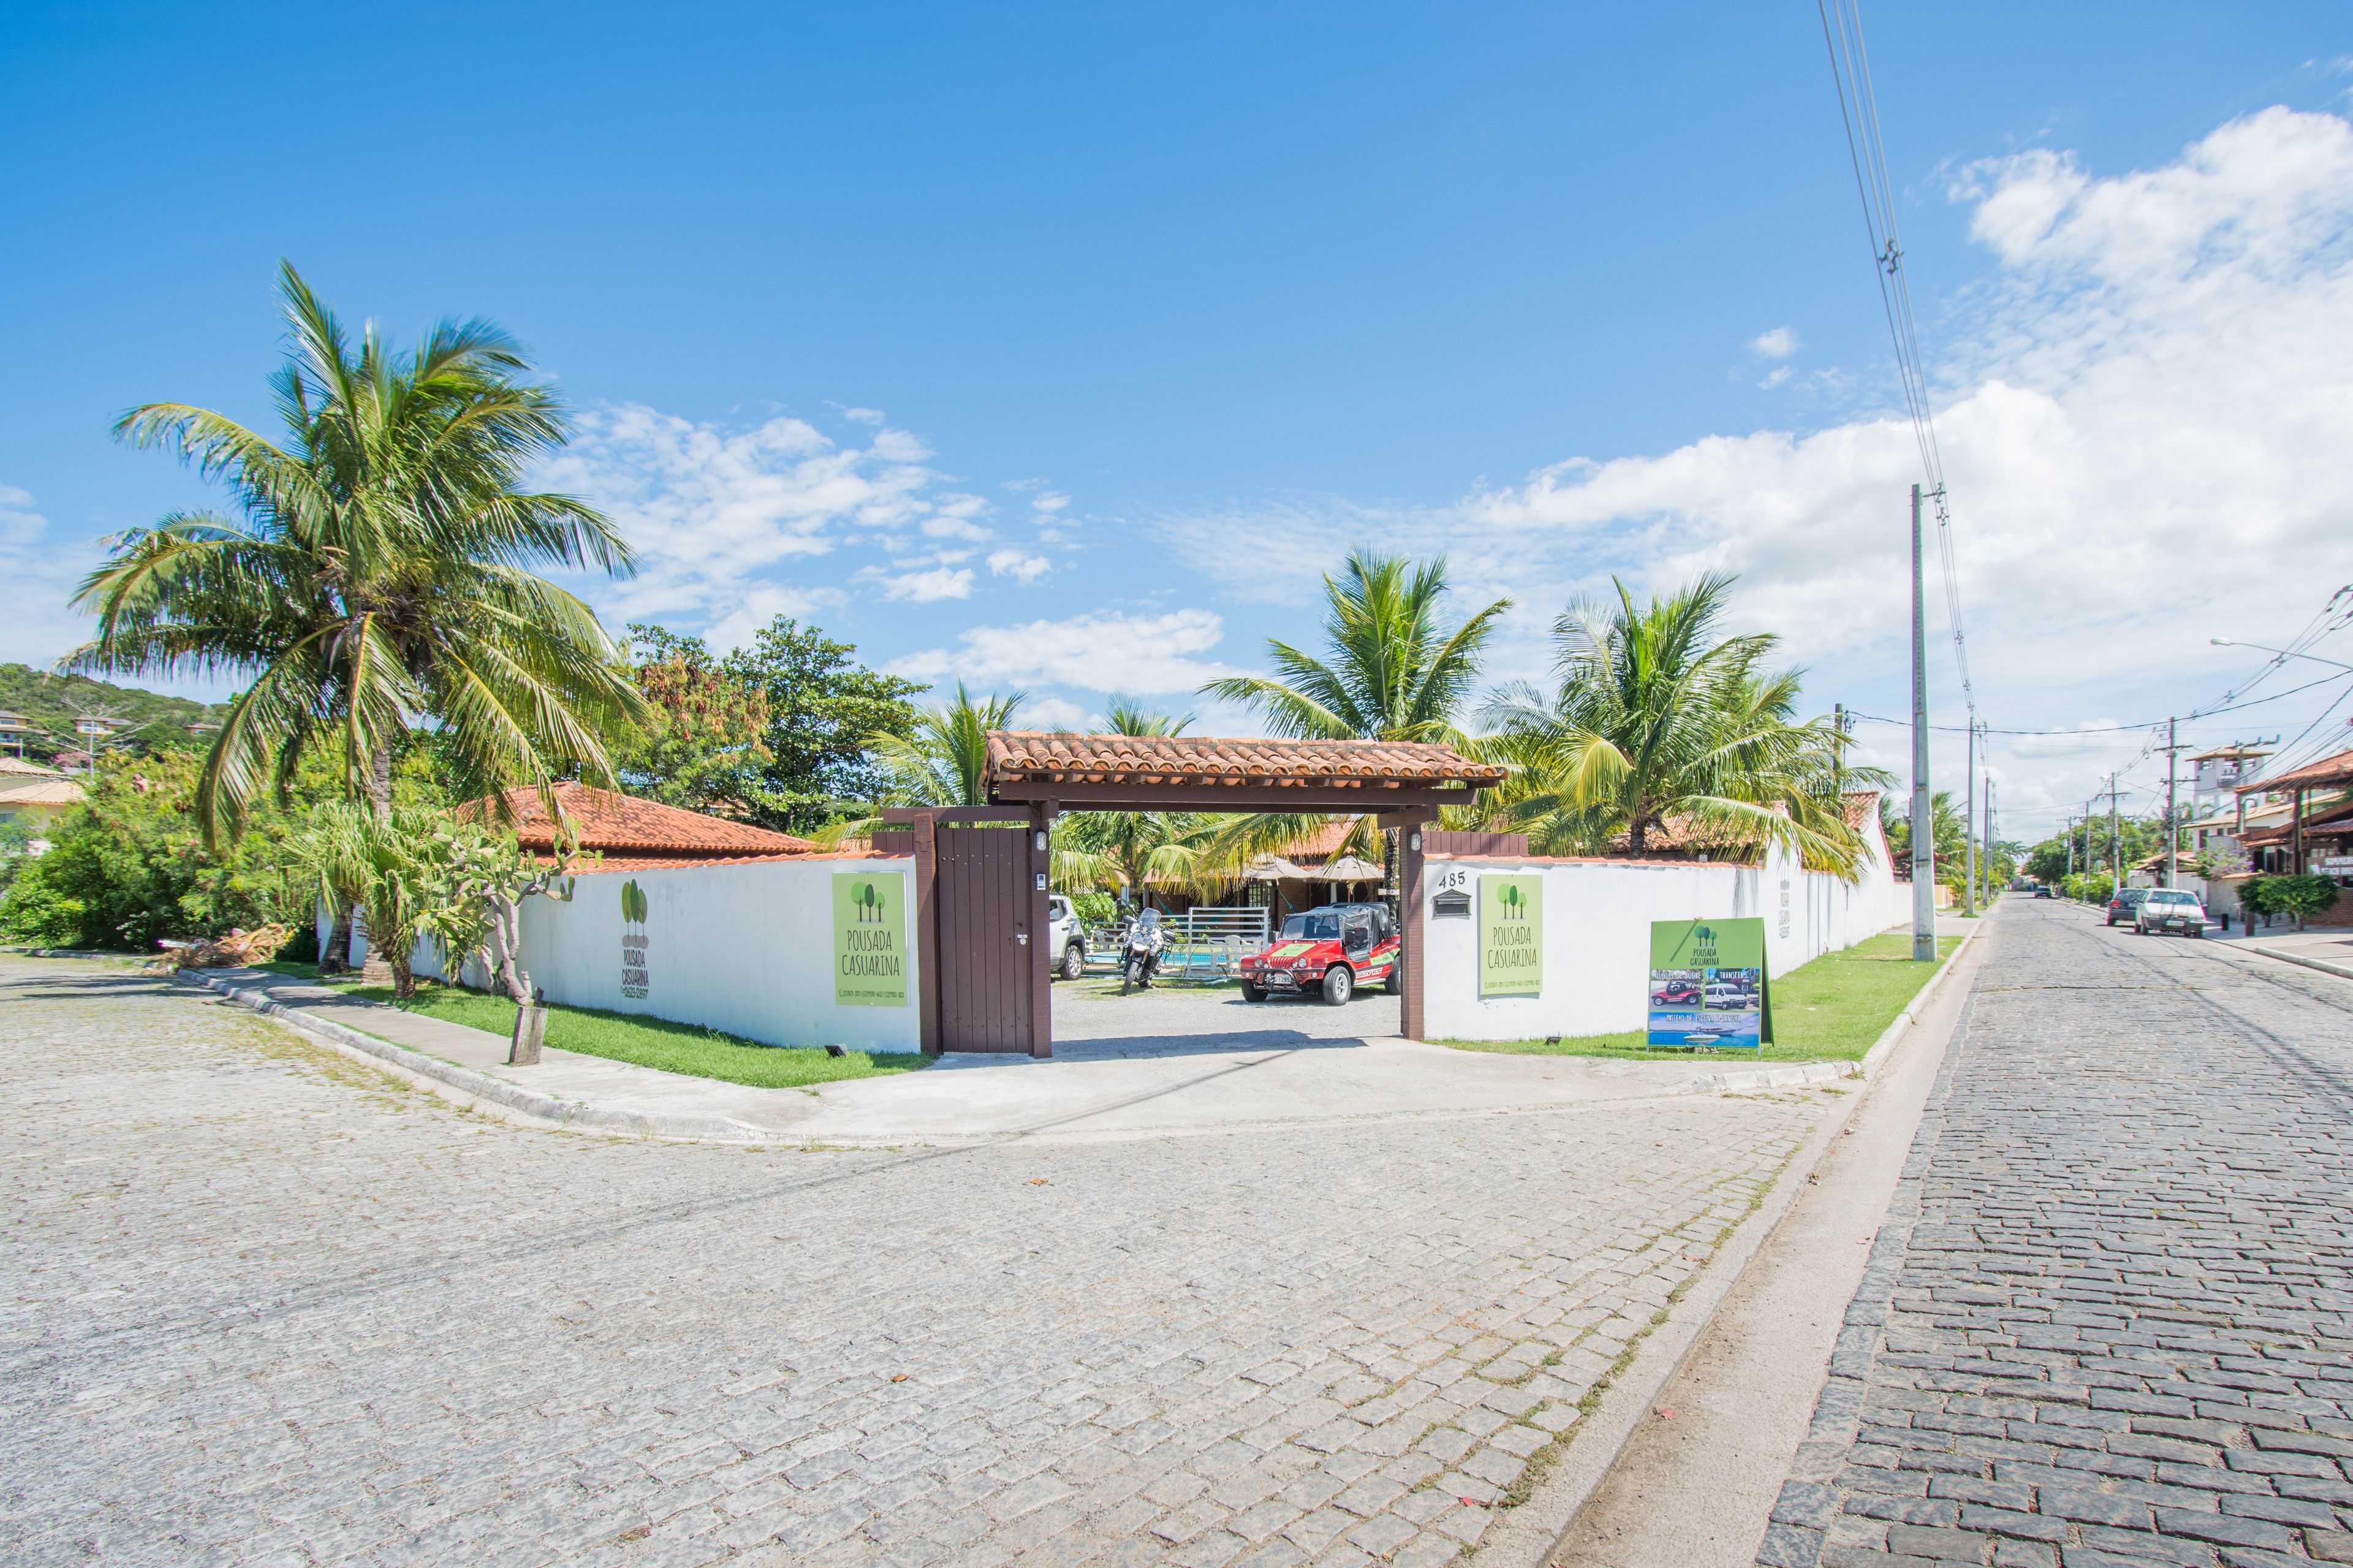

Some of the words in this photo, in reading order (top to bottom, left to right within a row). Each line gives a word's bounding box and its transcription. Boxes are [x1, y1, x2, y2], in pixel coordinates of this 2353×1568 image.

[1439, 871, 1466, 888] 485
[847, 930, 892, 951] POUSADA
[1493, 926, 1531, 946] POUSADA
[624, 949, 646, 968] POUSADA
[1488, 948, 1537, 969] CASUARINA
[1690, 957, 1719, 966] CASUARINA
[1693, 948, 1717, 957] POUSADA
[842, 955, 900, 976] CASUARINA
[622, 969, 650, 987] CASUARINA
